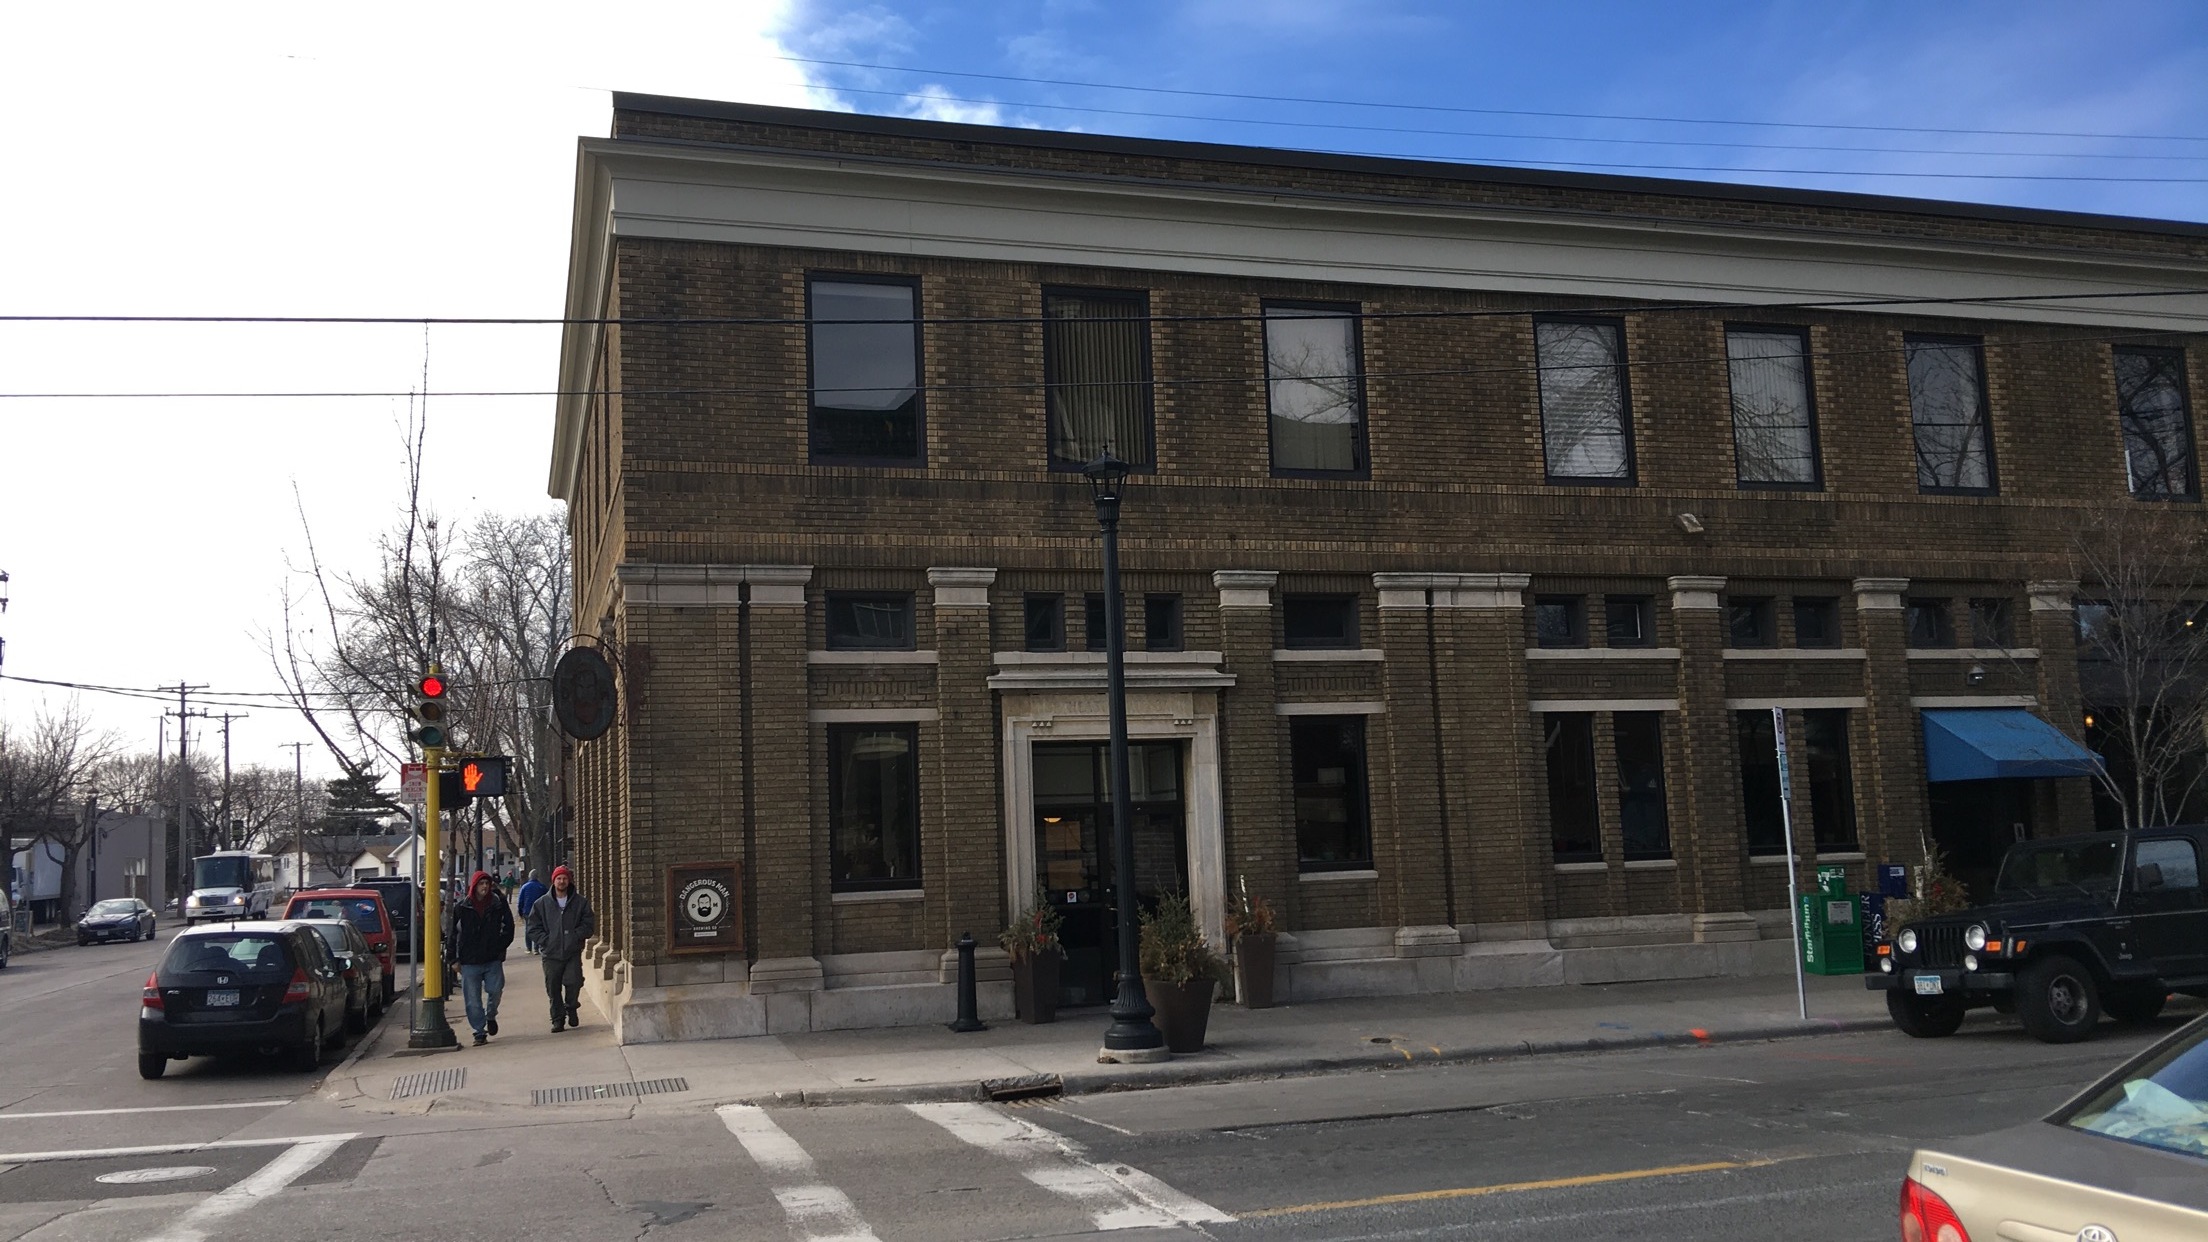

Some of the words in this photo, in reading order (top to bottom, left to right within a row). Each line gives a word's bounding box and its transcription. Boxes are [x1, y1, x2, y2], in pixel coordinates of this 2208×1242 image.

[679, 879, 716, 900] DANGEROUS
[715, 883, 730, 898] MAN
[1861, 894, 1873, 957] PIONEER
